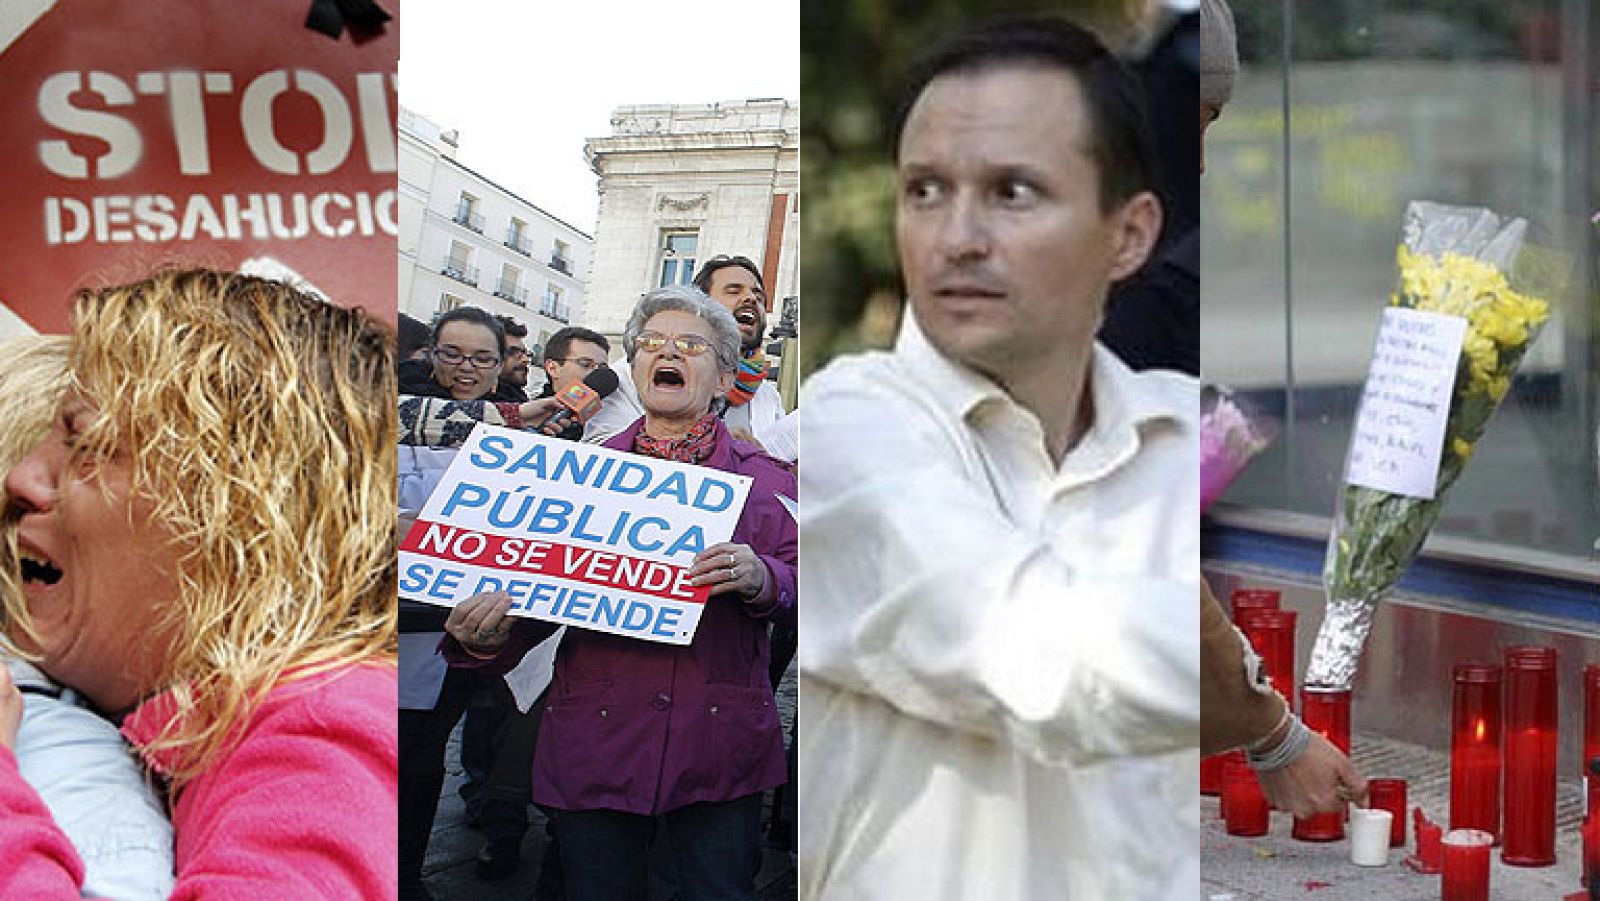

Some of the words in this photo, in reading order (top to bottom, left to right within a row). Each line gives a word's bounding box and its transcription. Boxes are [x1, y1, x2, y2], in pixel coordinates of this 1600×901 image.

[470, 435, 734, 513] SANIDAD
[440, 481, 705, 557] PÚBLICA
[399, 562, 466, 600] SE
[418, 523, 488, 561] NO
[495, 539, 553, 570] SE
[562, 545, 696, 598] VENDE
